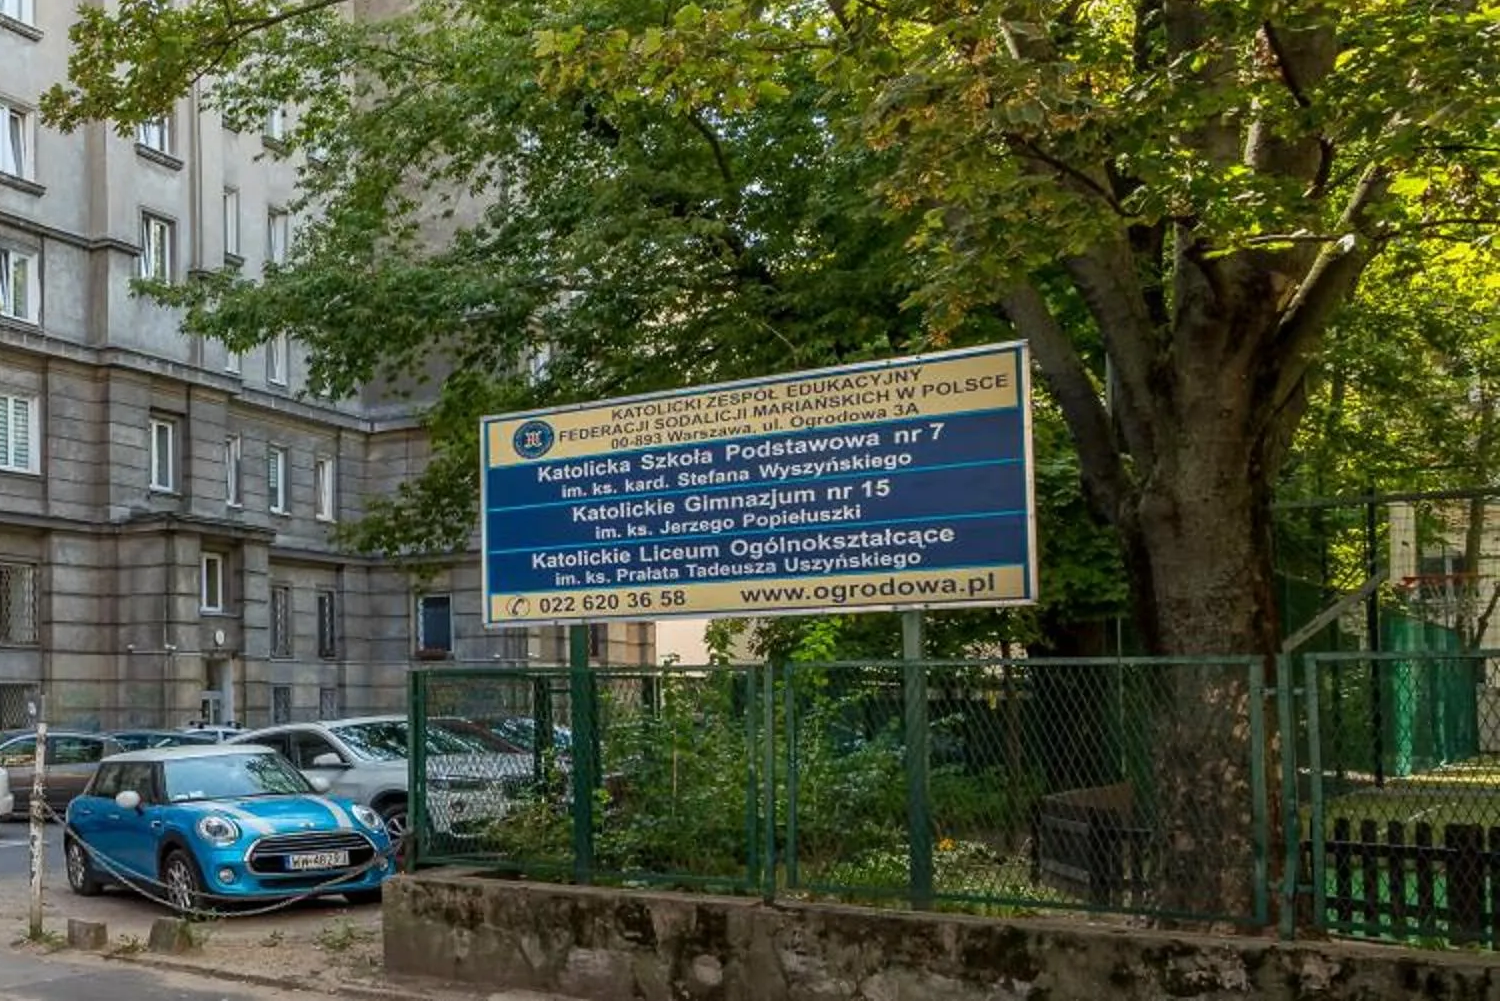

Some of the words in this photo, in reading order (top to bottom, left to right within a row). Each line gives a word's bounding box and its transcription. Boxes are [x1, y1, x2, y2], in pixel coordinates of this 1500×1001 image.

[559, 420, 649, 442] FEDERACJI
[655, 408, 746, 431] SODALICJI
[753, 389, 889, 418] MARIAŃSKICH
[896, 386, 915, 399] W
[922, 374, 1008, 398] POLSCE
[612, 399, 700, 421] KATOLICKI
[706, 388, 777, 408] ZESPÓŁ
[787, 367, 923, 398] EDUKACYJNY
[611, 434, 662, 450] 00-893
[763, 418, 783, 432] ul.
[790, 405, 887, 429] Ogrodowa
[894, 402, 920, 416] 3A
[537, 458, 631, 483] Katolicka
[641, 446, 713, 471] Szkoła
[725, 430, 880, 462] Podstawowa
[894, 426, 923, 445] nr
[929, 422, 946, 441] 7
[562, 484, 587, 499] im.
[592, 481, 617, 495] ks.
[625, 476, 669, 493] kard.
[677, 469, 750, 487] Stefana
[759, 453, 912, 480] Wyszyńskiego
[572, 499, 675, 523] Katolickie
[684, 488, 816, 513] Gimnazjum
[827, 484, 853, 501] nr
[861, 478, 891, 499] 15
[595, 526, 622, 540] im.
[627, 523, 652, 538] ks.
[660, 516, 735, 535] Jerzego
[743, 503, 862, 530] Popiełuszki
[531, 548, 631, 570] Katolickie
[640, 542, 719, 563] Liceum
[729, 527, 956, 560] Ogólnokształcące
[555, 572, 581, 586] im.
[585, 569, 611, 584] ks.
[617, 566, 679, 583] Prałata
[686, 559, 777, 578] Tadeusza
[784, 551, 922, 574] Uszyńskiego
[539, 596, 575, 614] 022
[583, 594, 619, 611] 620
[627, 592, 651, 609] 36
[660, 590, 686, 607] 58
[740, 572, 995, 605] www.ogrodowa.pl
